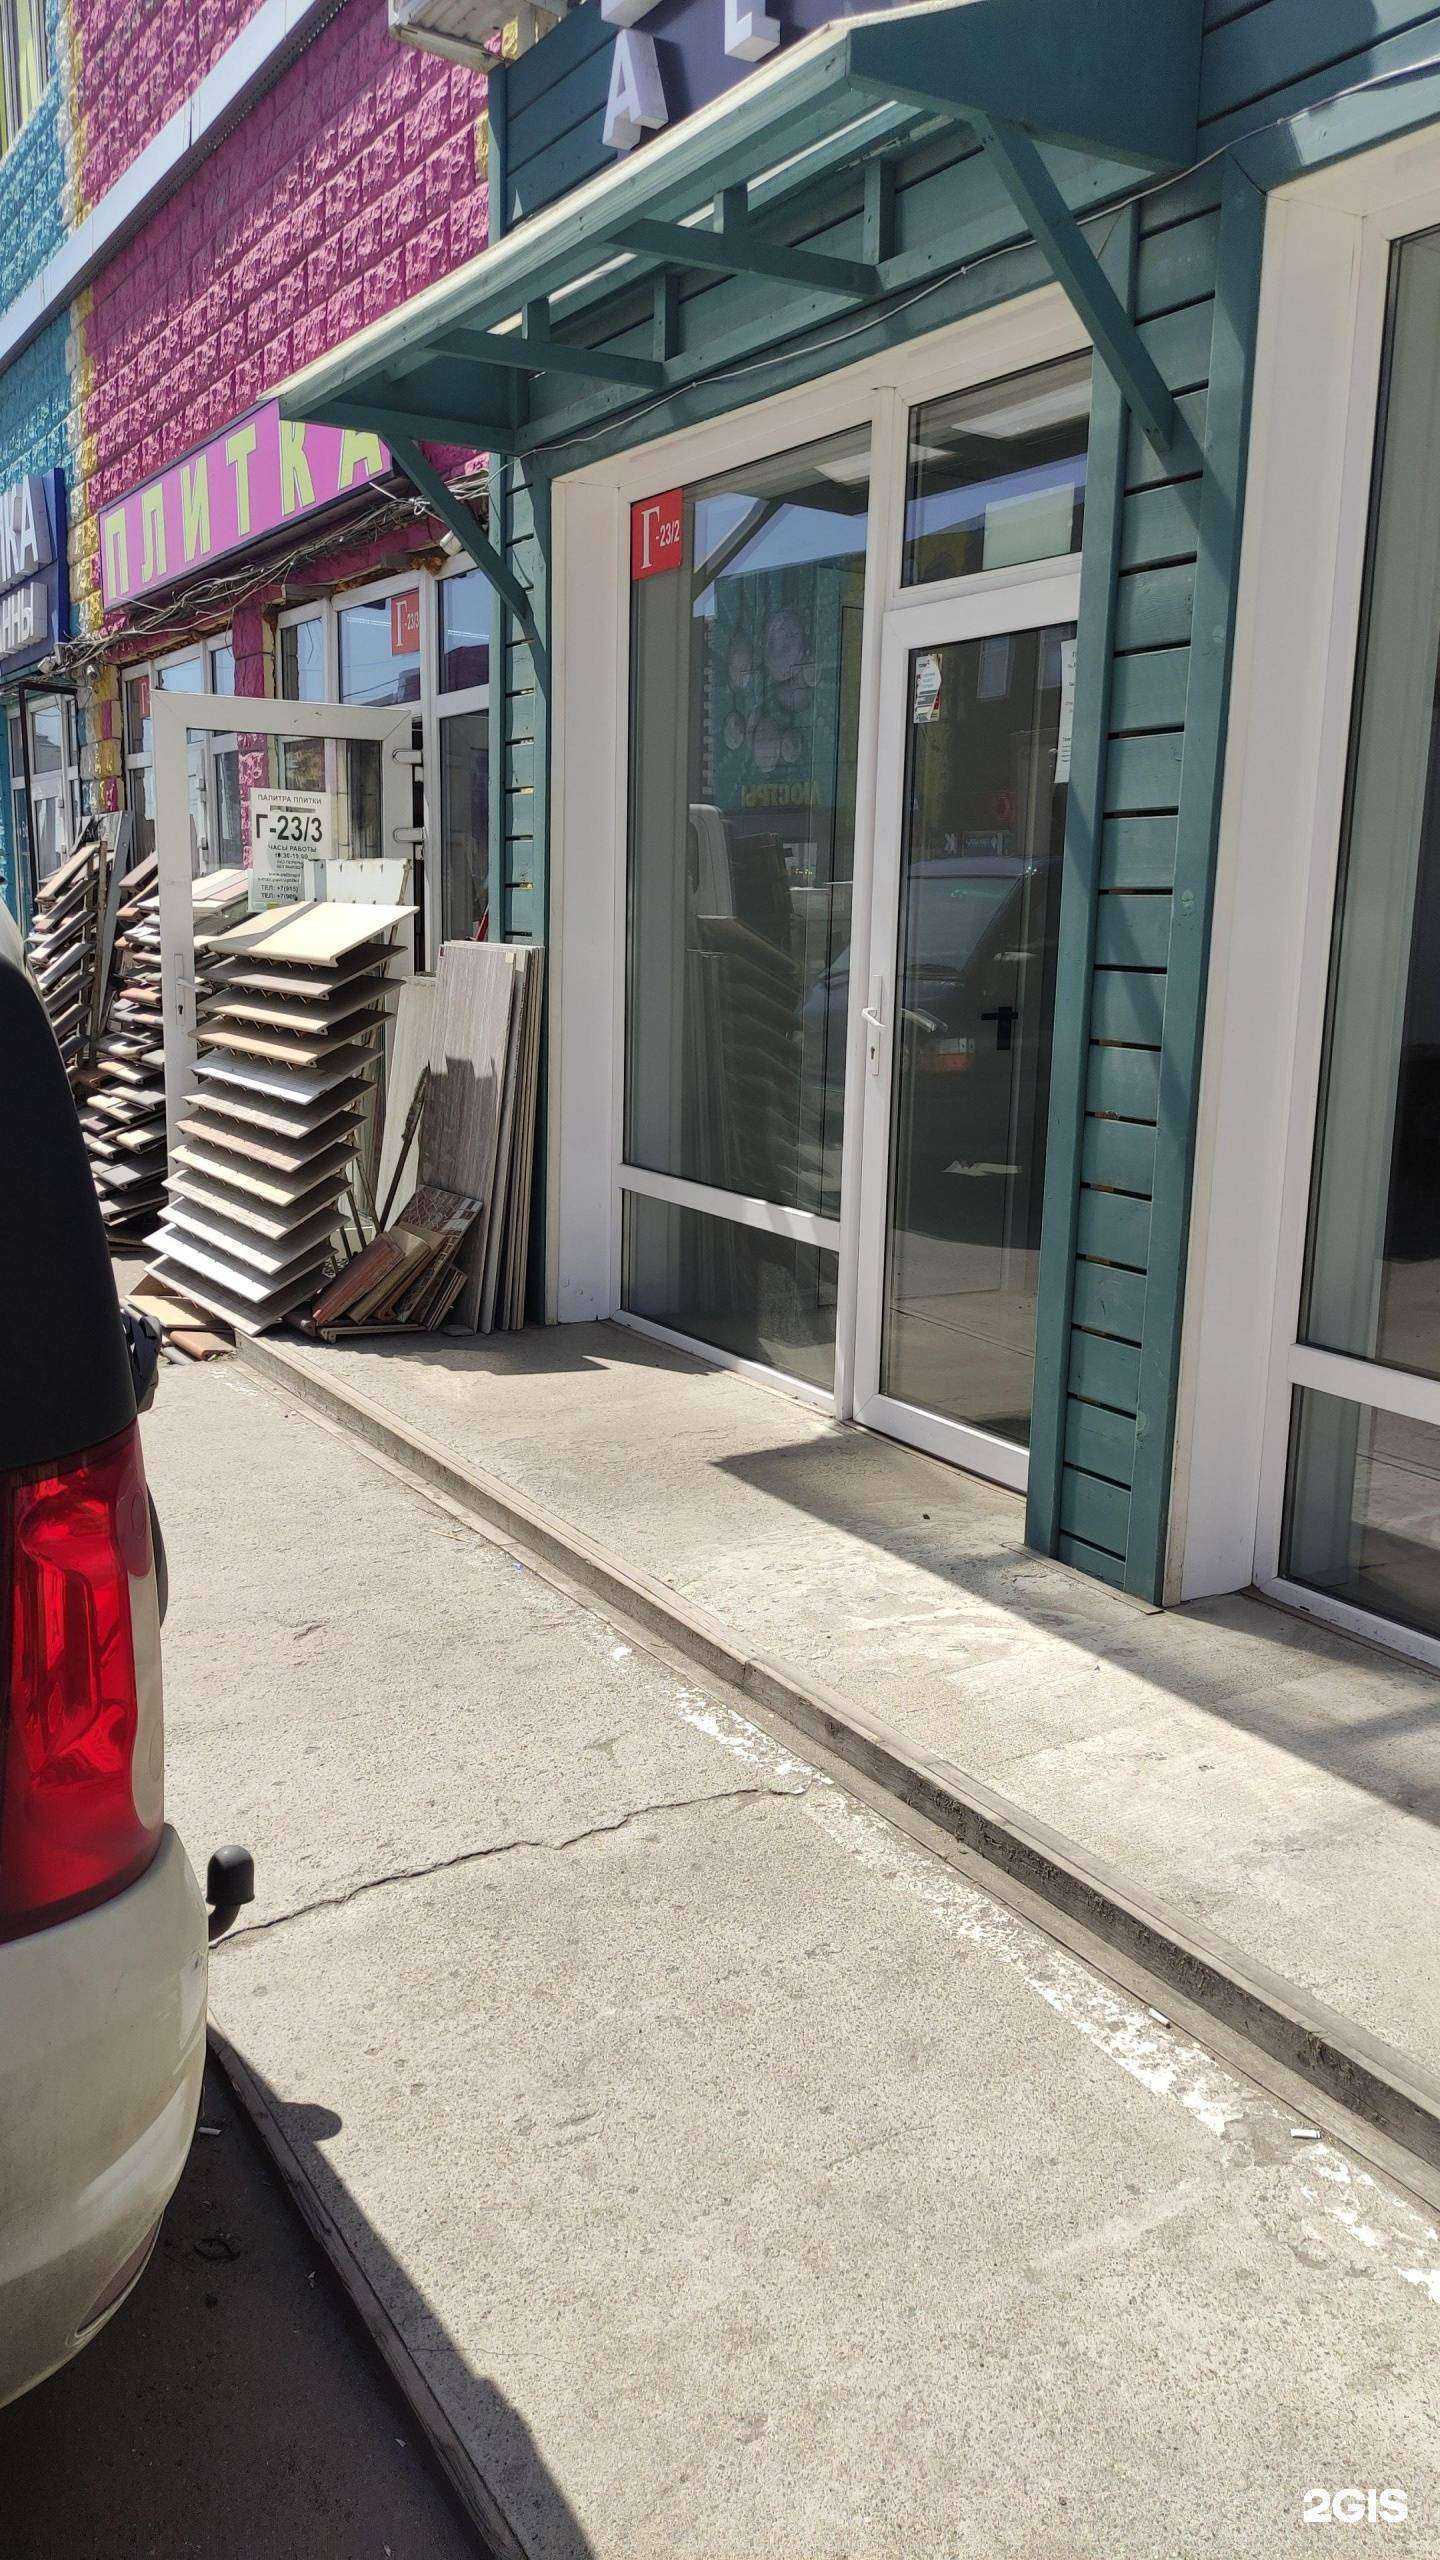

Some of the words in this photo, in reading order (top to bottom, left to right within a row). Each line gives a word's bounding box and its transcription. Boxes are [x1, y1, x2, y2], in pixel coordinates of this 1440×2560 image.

[104, 420, 384, 600] ПЛИТКА
[640, 505, 681, 569] Г-23/2
[257, 794, 292, 803] ПАЛИТРА
[293, 796, 322, 805] ПЛИТКИ
[255, 813, 323, 843] Г-23/3
[289, 845, 317, 853] РАБОТЫ
